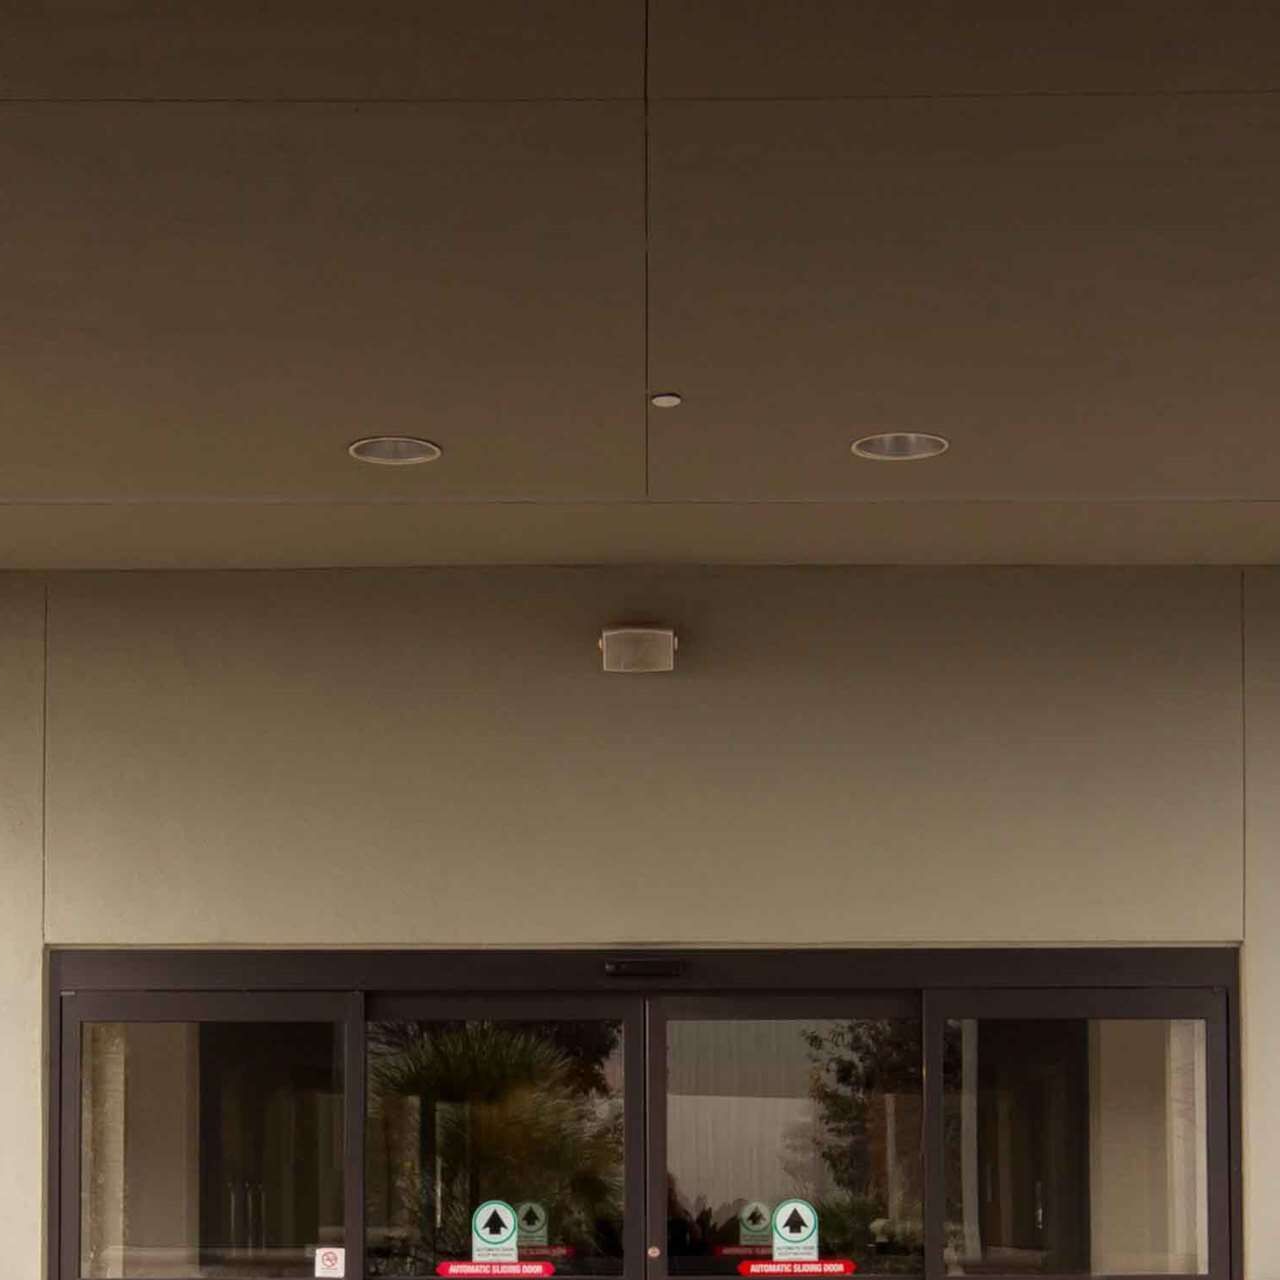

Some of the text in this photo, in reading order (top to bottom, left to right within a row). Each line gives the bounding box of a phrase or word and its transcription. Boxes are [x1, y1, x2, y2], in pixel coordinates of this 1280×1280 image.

[448, 1264, 543, 1274] AUTOMATIC SLIDING DOOR
[750, 1263, 845, 1273] AUTOMATIC SLIDING DOOR
